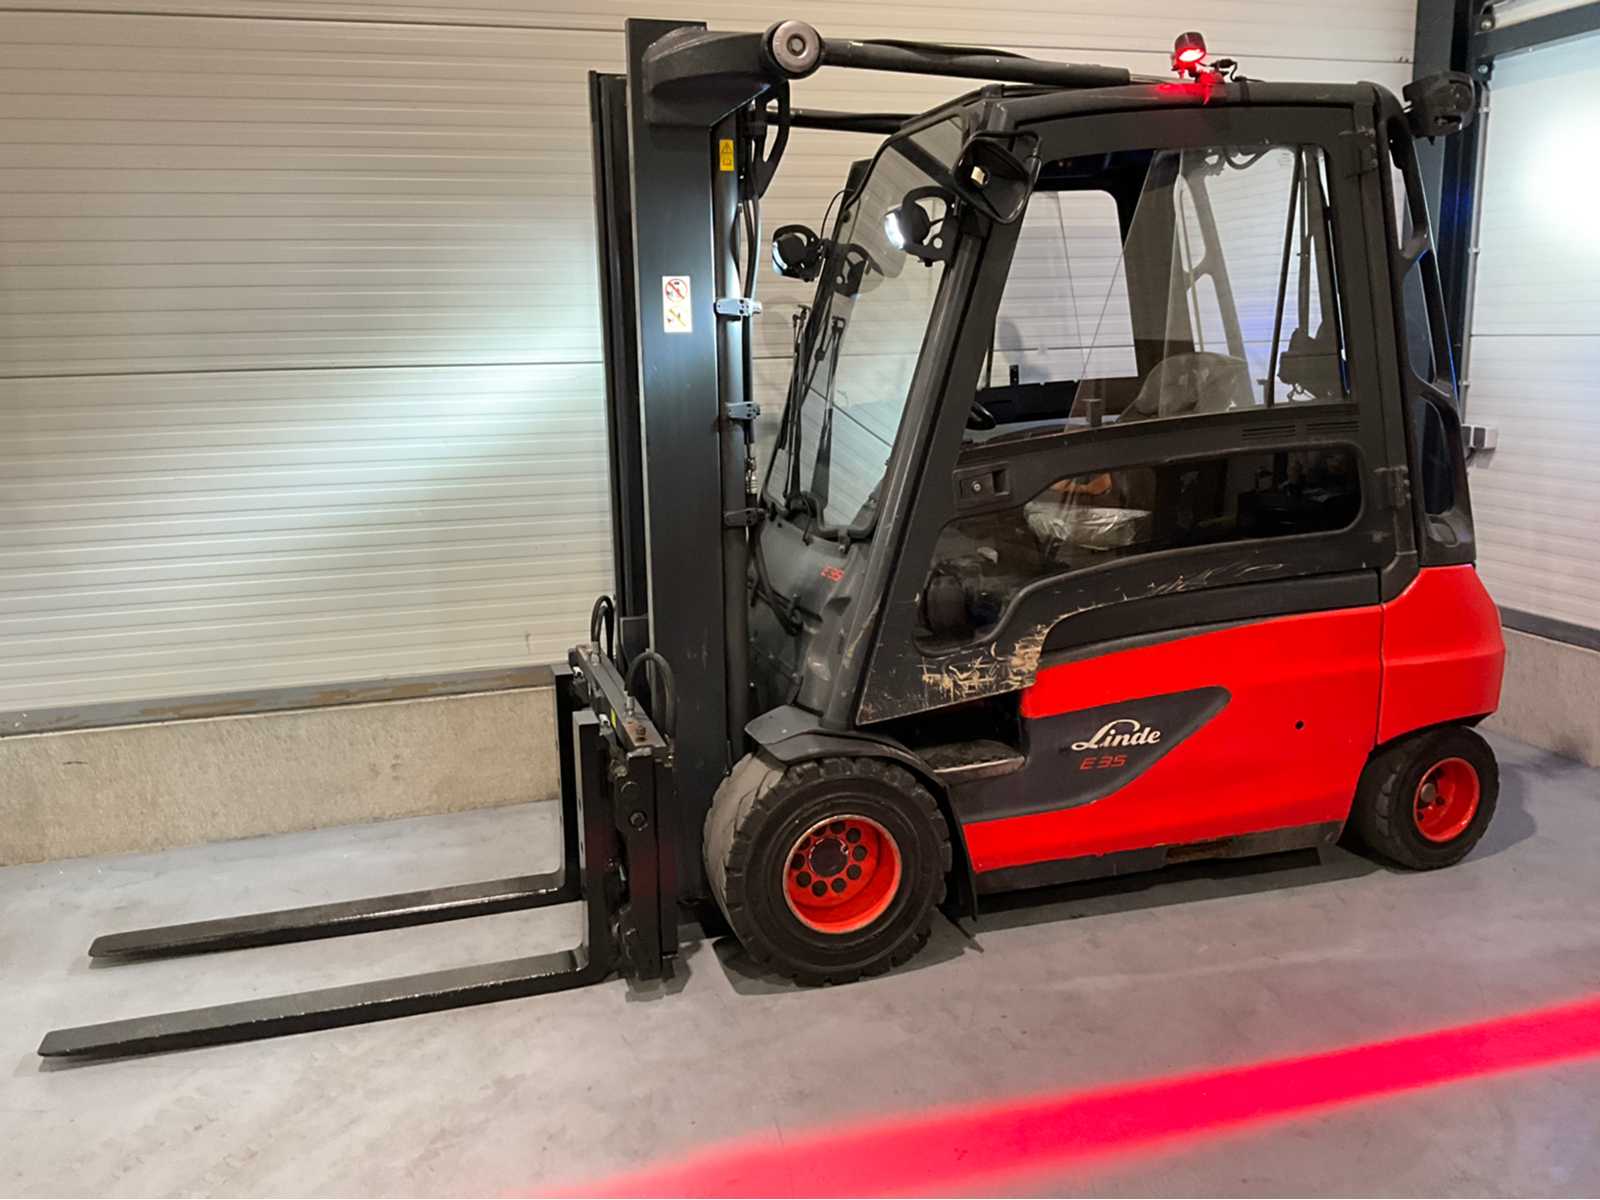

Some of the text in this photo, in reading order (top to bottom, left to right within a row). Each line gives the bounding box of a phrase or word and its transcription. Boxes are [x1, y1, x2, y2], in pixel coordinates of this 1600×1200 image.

[1071, 719, 1161, 751] Linde
[1080, 754, 1128, 770] E 35
